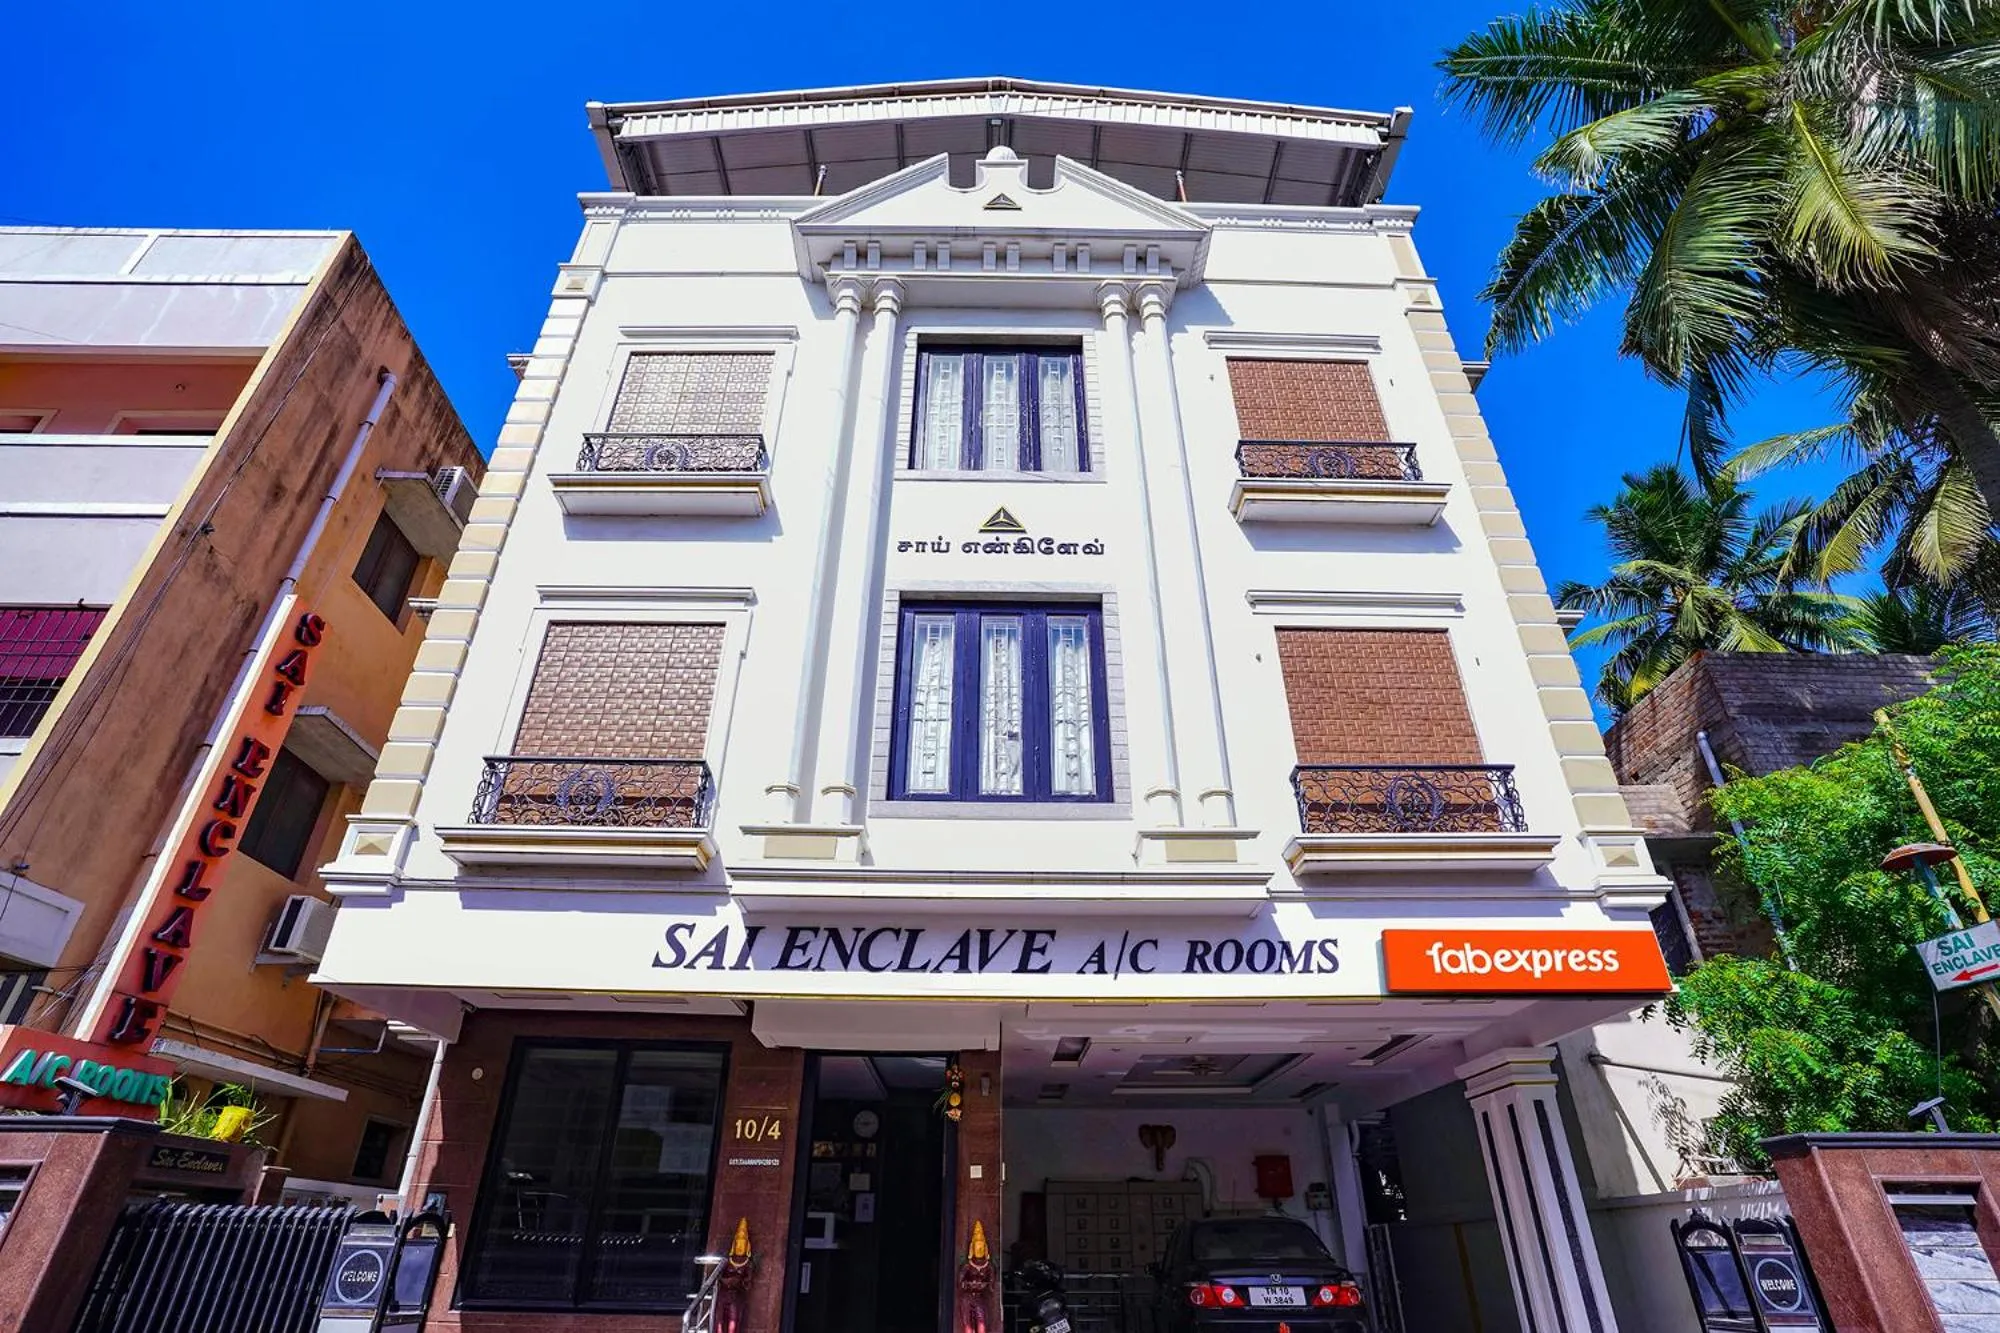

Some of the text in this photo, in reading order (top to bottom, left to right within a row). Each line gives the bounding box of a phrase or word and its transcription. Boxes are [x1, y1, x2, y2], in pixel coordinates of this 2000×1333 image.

[897, 536, 950, 553] சாய்
[110, 612, 326, 1044] SAI ENCLAVE
[651, 922, 1340, 980] SAI ENCLAVE A/C ROOMS
[1937, 932, 1975, 956] SAI
[1426, 942, 1619, 978] fabexpress
[1932, 943, 2000, 976] ENCLAVE
[0, 1049, 173, 1106] A/C ROOMS
[735, 1116, 781, 1141] 10/4
[341, 1270, 378, 1282] WELCOME
[1760, 1278, 1797, 1291] WELCOME
